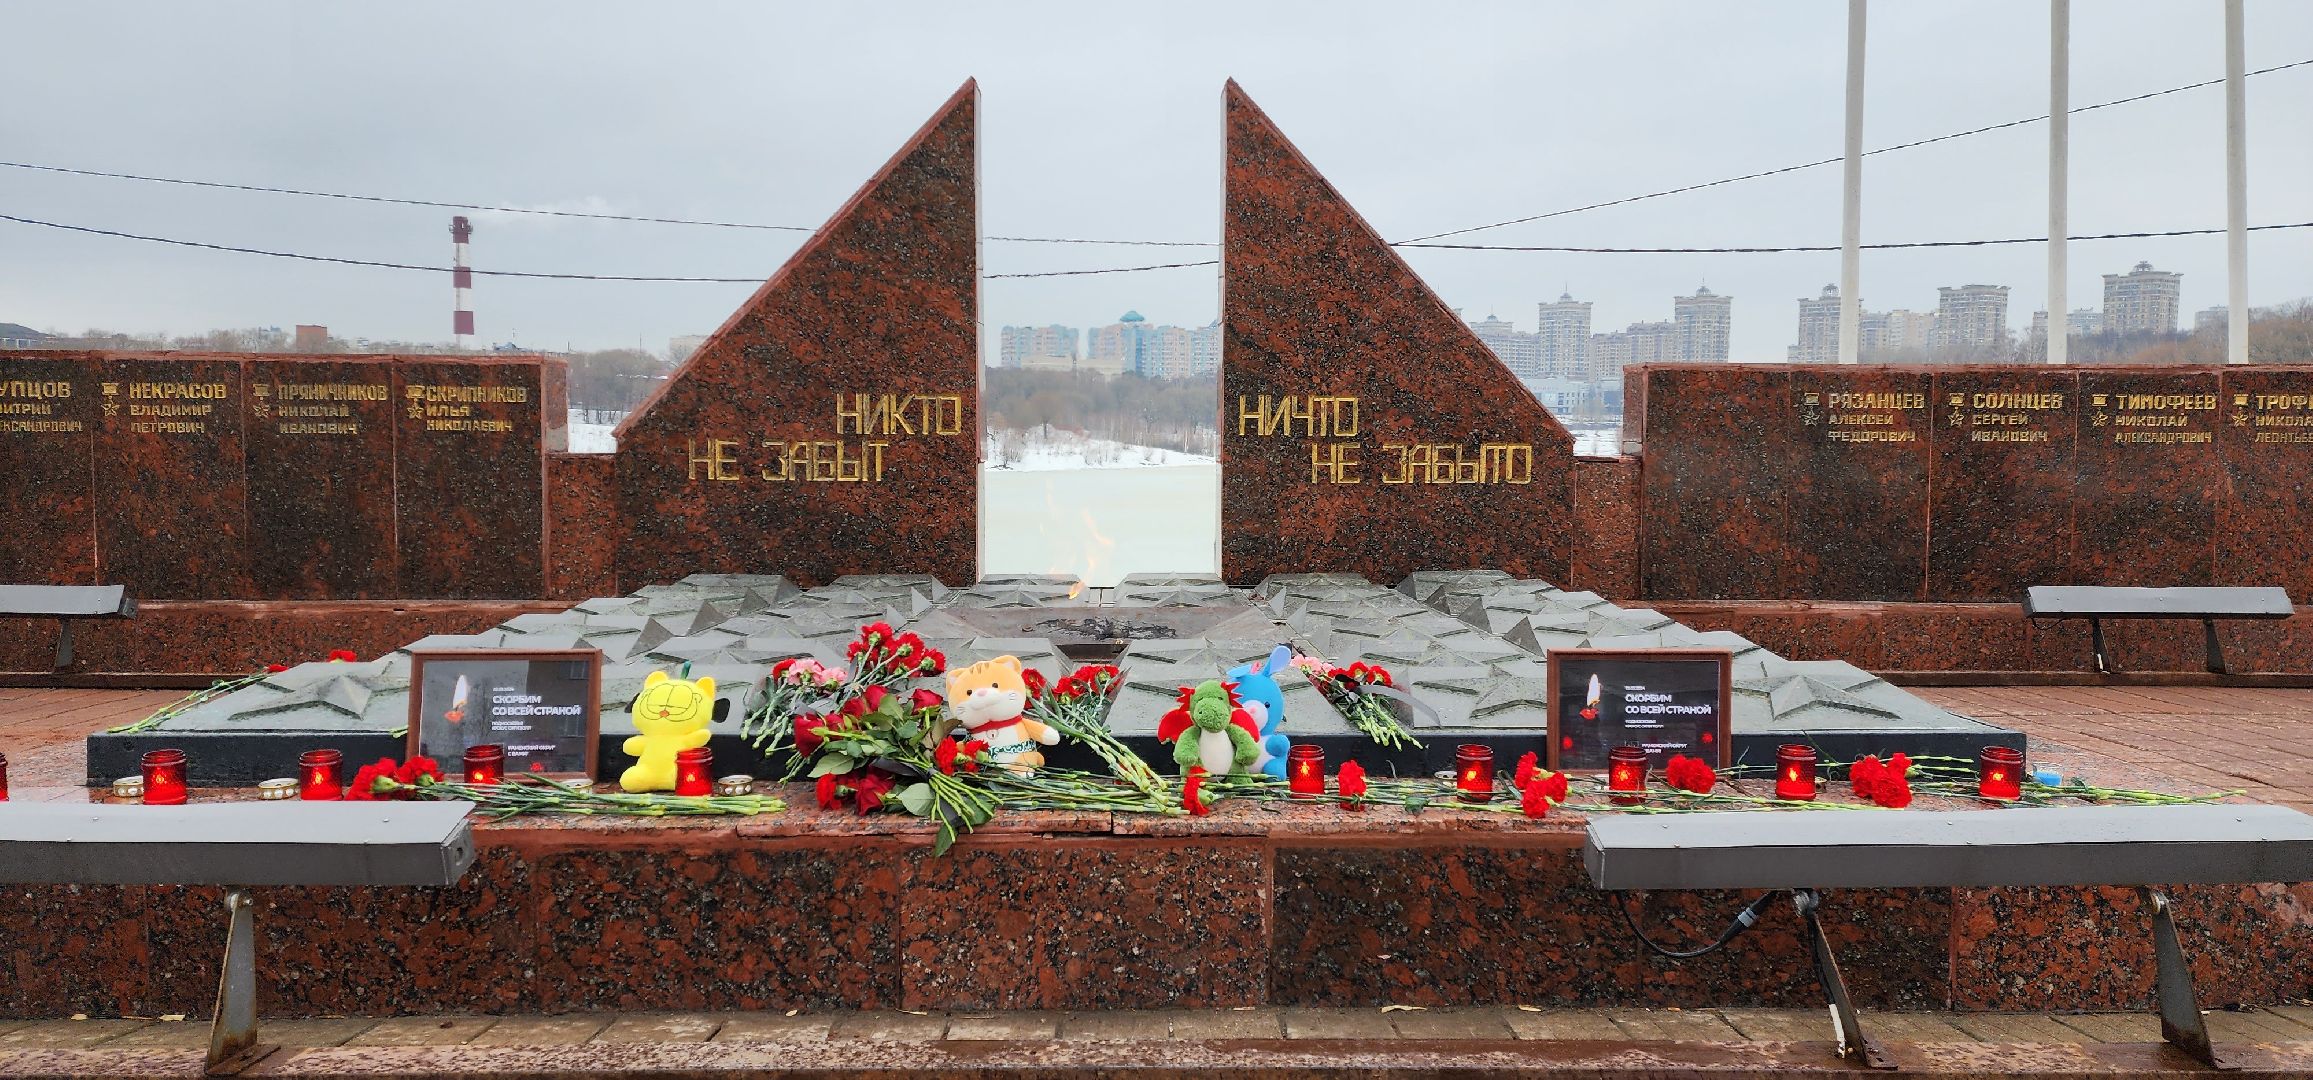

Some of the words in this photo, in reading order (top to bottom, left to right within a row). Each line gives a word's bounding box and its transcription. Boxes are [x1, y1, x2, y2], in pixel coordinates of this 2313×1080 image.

[129, 382, 228, 399] НЕКРАСОВ
[278, 383, 389, 401] ПРЯНИЧНИКОВ
[426, 385, 528, 403] СКРИПНИКОВ
[1828, 392, 1925, 411] РЯЗАНЦЕВ
[1972, 392, 2064, 411] СОЛНЦЕВ
[2115, 393, 2217, 410] ТИМОФЕЕВ
[130, 404, 213, 417] ВЛАДИМИР
[278, 403, 351, 417] НИКОЛАЙ
[426, 404, 470, 417] ИЛЬЯ
[836, 393, 962, 436] НИКТО
[1238, 394, 1359, 437] НИЧТО
[1828, 411, 1894, 425] АЛЕКСЕЙ
[1972, 411, 2028, 425] СЕРГЕЙ
[2115, 413, 2188, 427] НИКОЛАЙ
[2255, 415, 2313, 427] НИКОЛА
[131, 421, 205, 434] ПЕТРОВИЧ
[279, 421, 358, 434] ИВАНОВИЧ
[426, 420, 513, 433] НИКОЛАЕВИЧ
[1828, 430, 1916, 442] ФЕДОРОВИЧ
[1972, 430, 2049, 442] ИВАНОВИЧ
[2115, 431, 2212, 445] АЛЕКСАНДРОВИЧ
[688, 438, 740, 480] НЕ
[761, 439, 889, 482] ЗАБЫТ
[1311, 442, 1361, 484] НЕ
[1382, 442, 1533, 484] ЗАБЫТО
[492, 696, 541, 704] СКОРБИМ
[1625, 694, 1672, 702] СКОРБИМ
[492, 706, 506, 715] СО
[507, 705, 533, 715] ВСЕЙ
[534, 705, 581, 715] СТРАНОЙ
[1625, 705, 1639, 714] СО
[1640, 704, 1665, 714] ВСЕЙ
[1666, 704, 1711, 714] СТРАНОЙ
